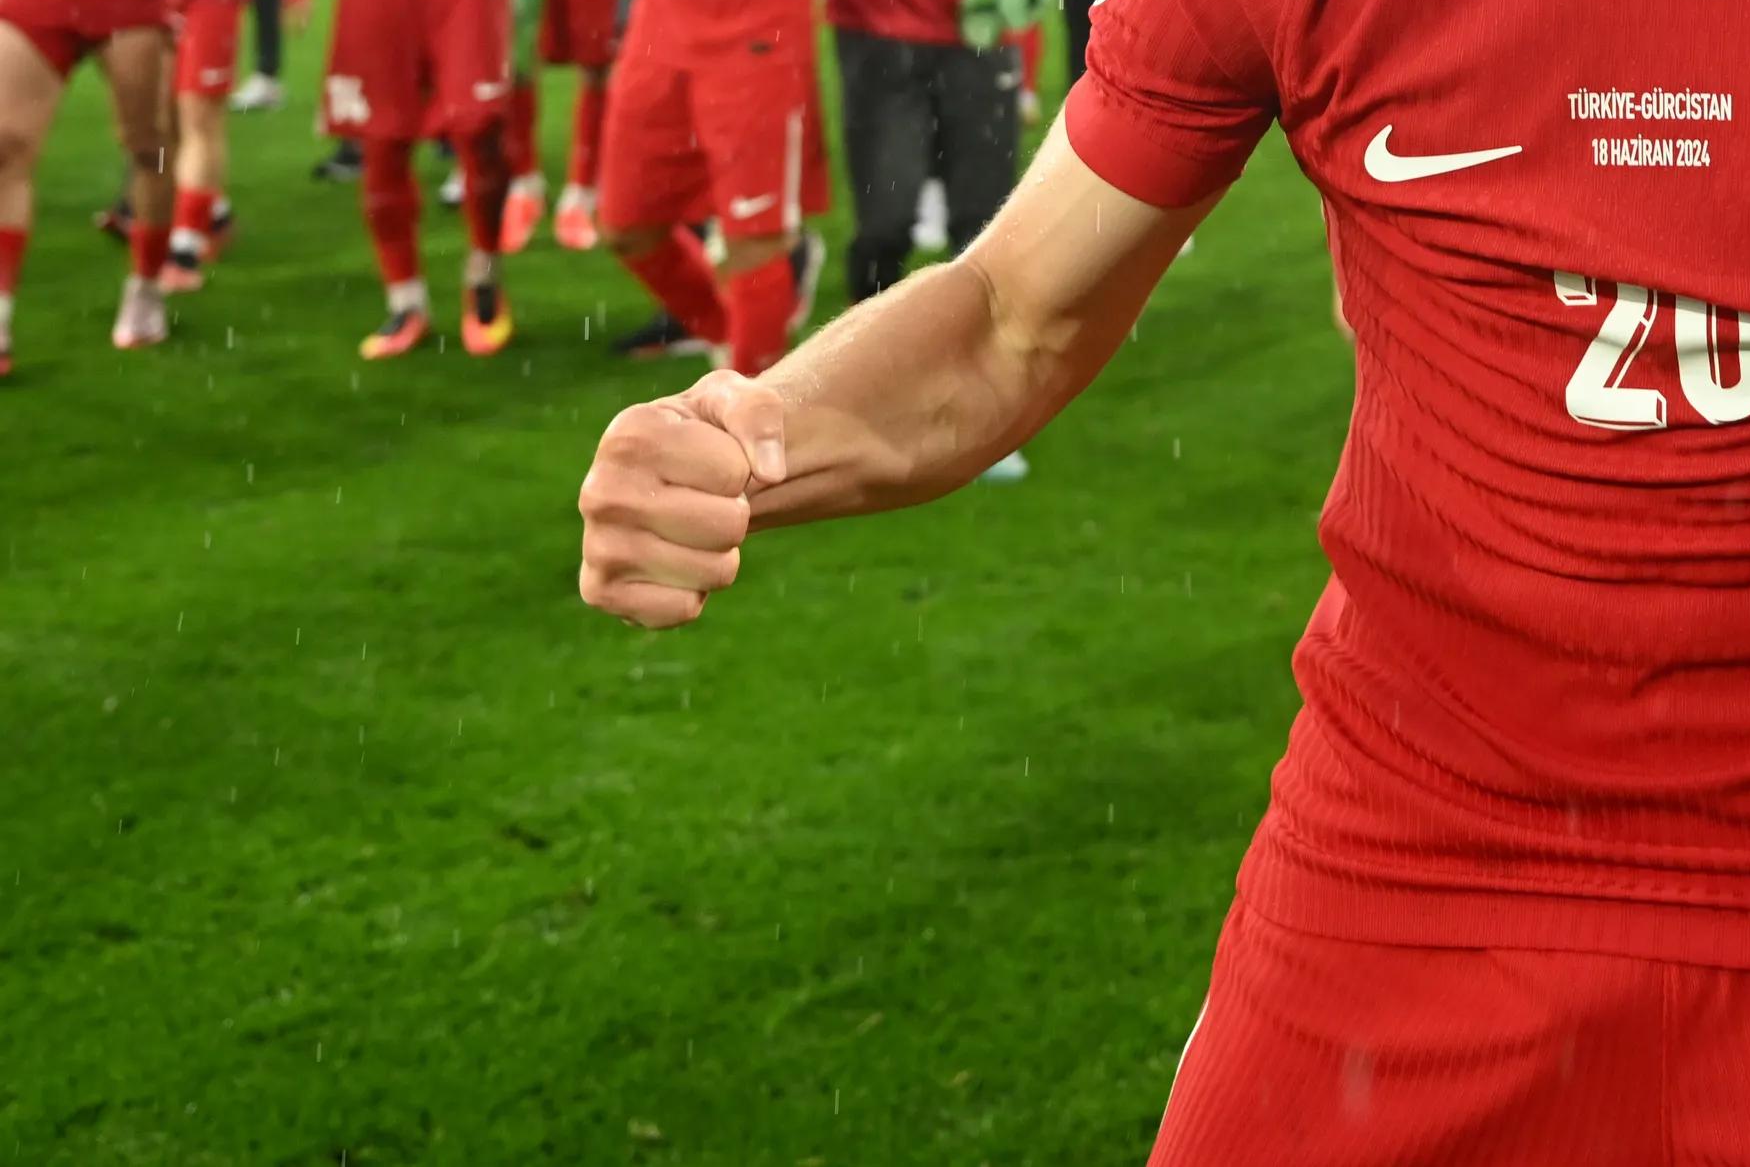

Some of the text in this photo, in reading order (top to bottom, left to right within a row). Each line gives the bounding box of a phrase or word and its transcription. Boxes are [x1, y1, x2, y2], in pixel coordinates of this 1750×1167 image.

[1567, 86, 1732, 121] TÜRKİYE-GÜRCİSTAN
[1591, 133, 1711, 167] 18 HAZİRAN 2024
